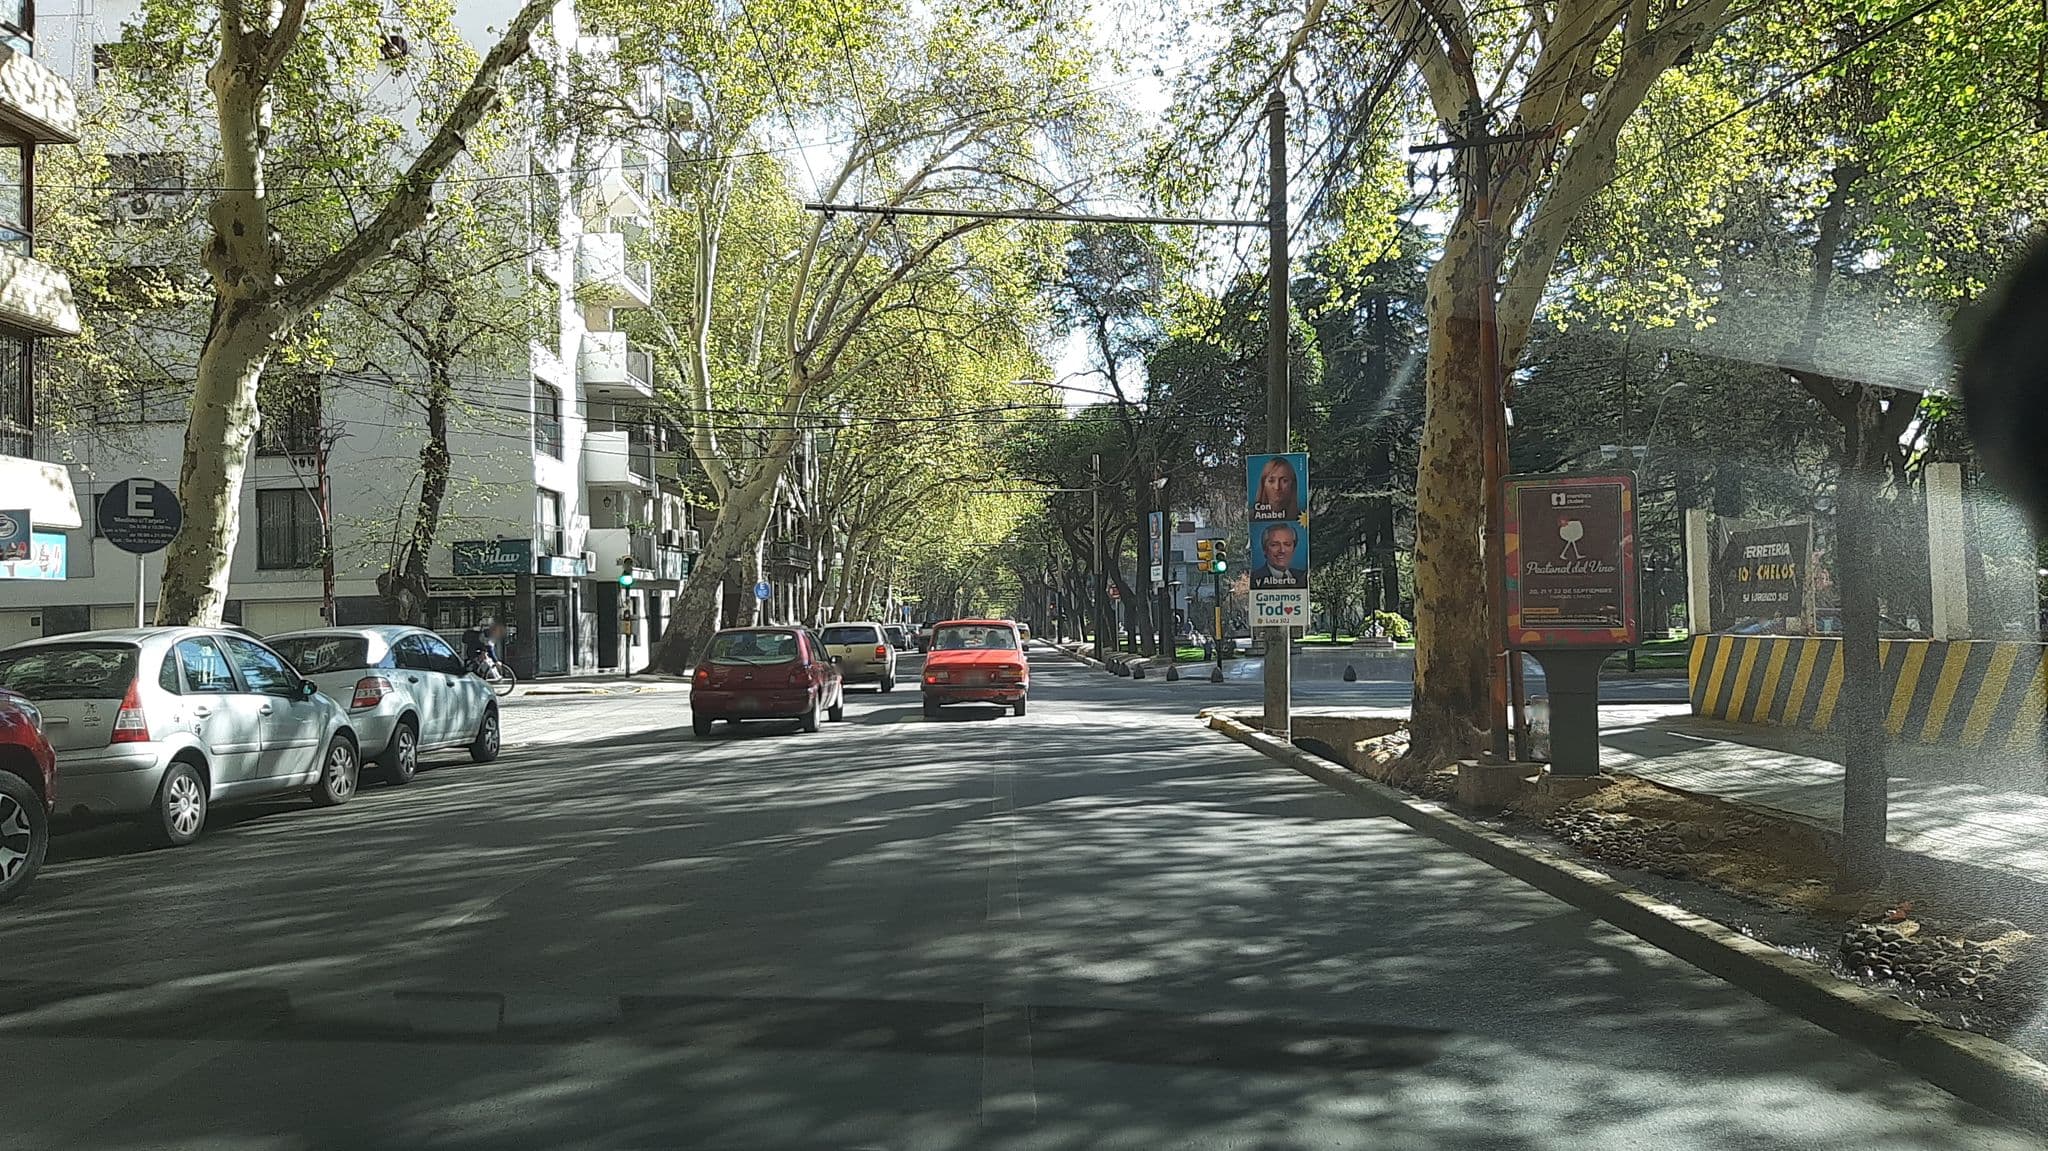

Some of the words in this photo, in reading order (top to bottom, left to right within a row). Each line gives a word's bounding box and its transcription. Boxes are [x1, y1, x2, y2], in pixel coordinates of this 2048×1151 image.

[128, 480, 155, 516] E
[1254, 502, 1272, 511] Con
[1254, 510, 1286, 520] Anabel
[1571, 560, 1587, 574] del
[1588, 560, 1615, 574] Vino
[1756, 562, 1796, 581] CHELOS
[1255, 578, 1262, 587] y
[1263, 576, 1297, 585] Alberto
[1256, 592, 1302, 602] Ganamos
